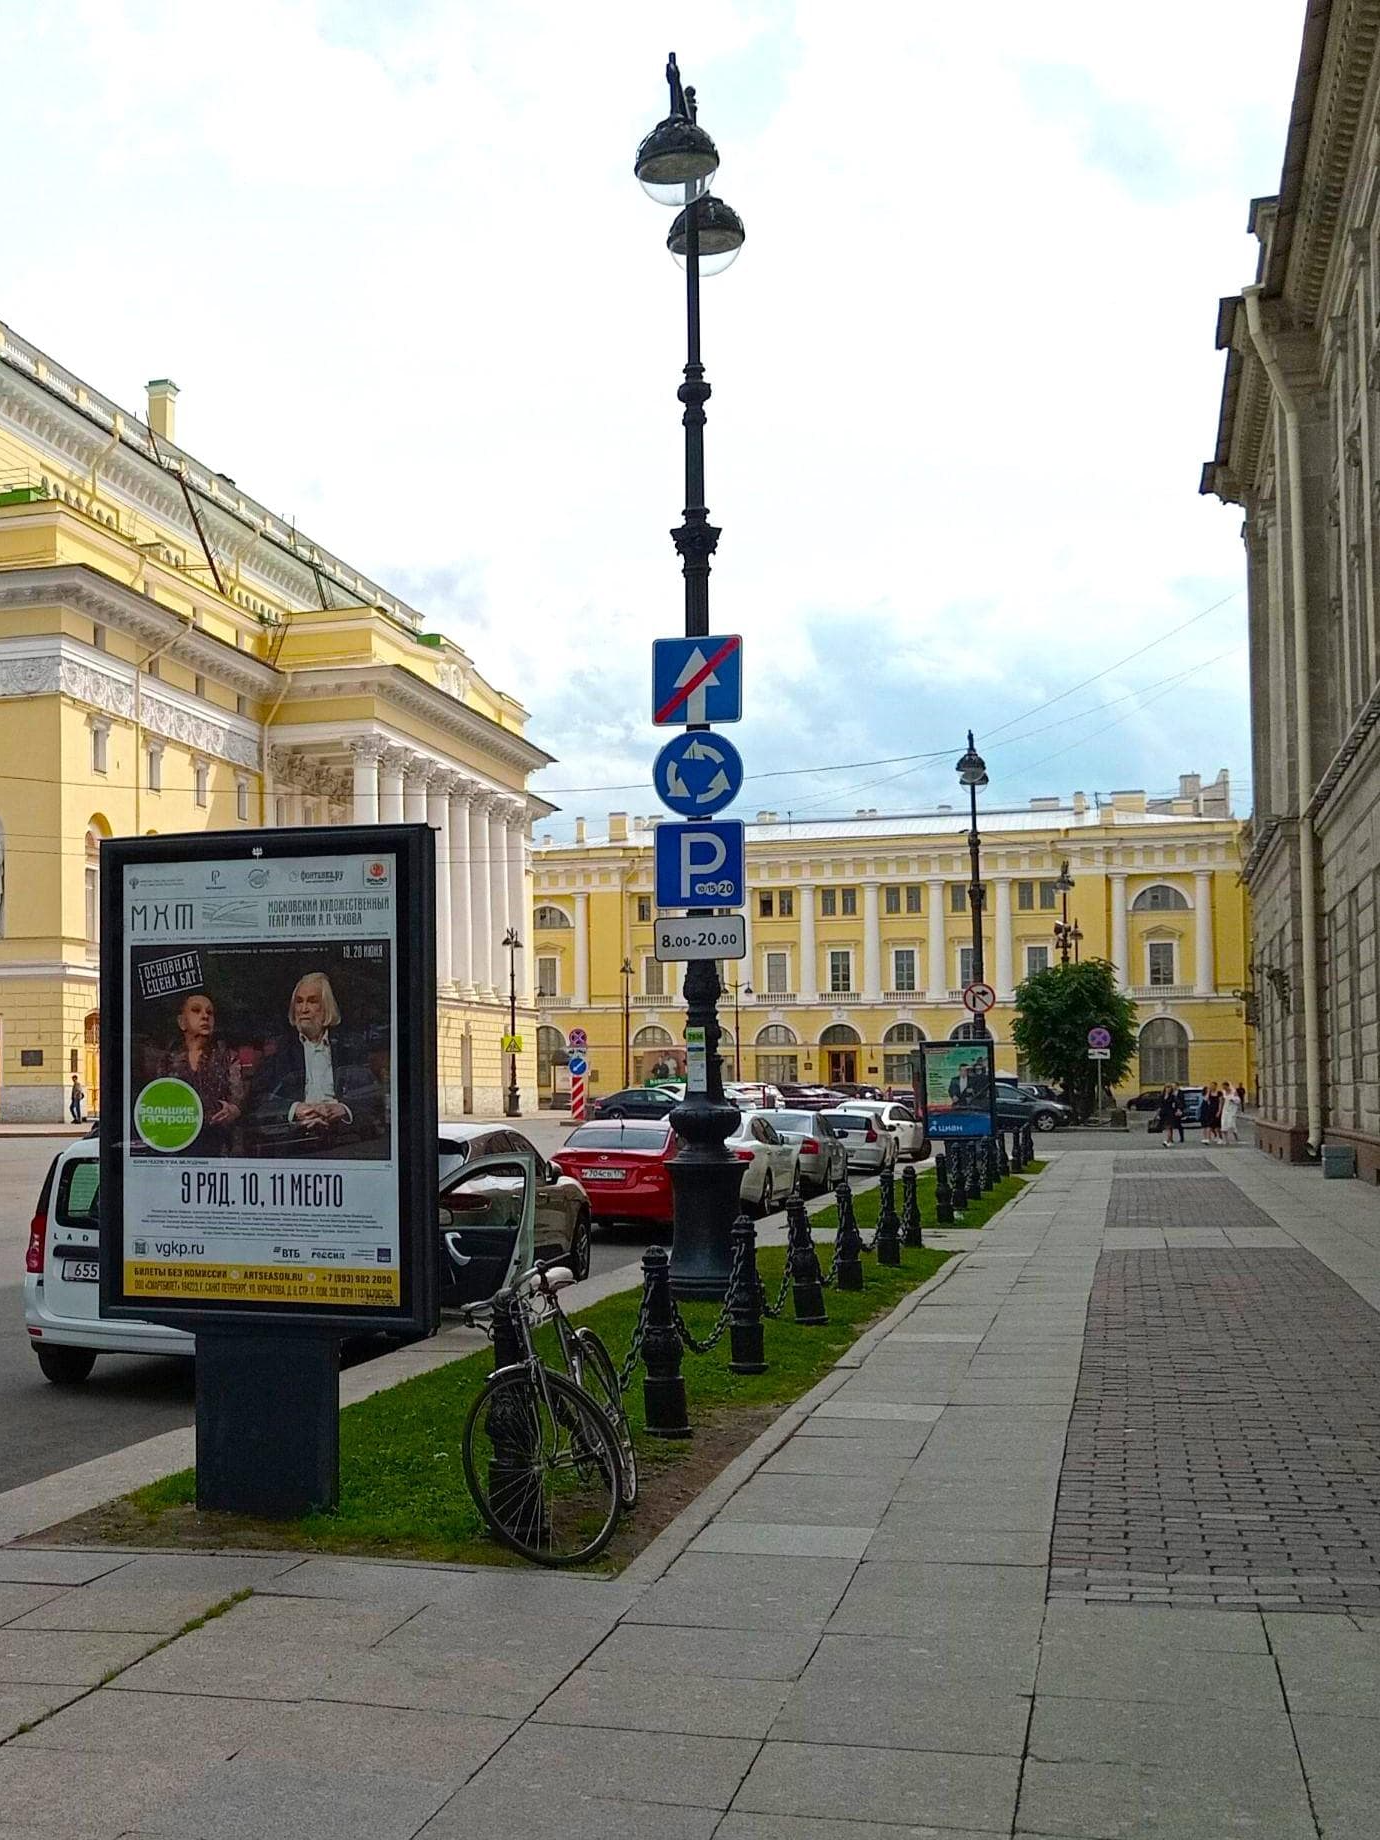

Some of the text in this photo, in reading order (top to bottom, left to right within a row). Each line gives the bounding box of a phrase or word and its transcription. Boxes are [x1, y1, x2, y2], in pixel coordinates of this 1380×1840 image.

[680, 832, 727, 898] P
[719, 883, 733, 894] 20
[267, 895, 390, 914] МОСКОВСКИЙ ХУДОЖЕСТВЕННЫЙ
[131, 903, 193, 932] МХТ
[268, 913, 289, 928] ТЕАТР
[291, 912, 316, 927] ИМЕНИ
[333, 911, 362, 926] ЧЕХОВА
[662, 932, 737, 948] 8.00-20.00
[144, 955, 194, 979] ОСНОВНАЯ
[146, 969, 197, 994] СЦЕНА БДТ
[181, 1171, 343, 1208] 9 РЯД. 10, 11 МЕСТО
[53, 1232, 89, 1242] LAD
[155, 1240, 205, 1257] vgkp.ru
[281, 1248, 300, 1258] ВТБ
[311, 1250, 345, 1260] РОССИЯ
[74, 1263, 98, 1278] 655
[134, 1267, 227, 1279] БИЛЕТЫ БЕЗ КОМИССИИ
[243, 1270, 303, 1281] ARTSEASON.RU
